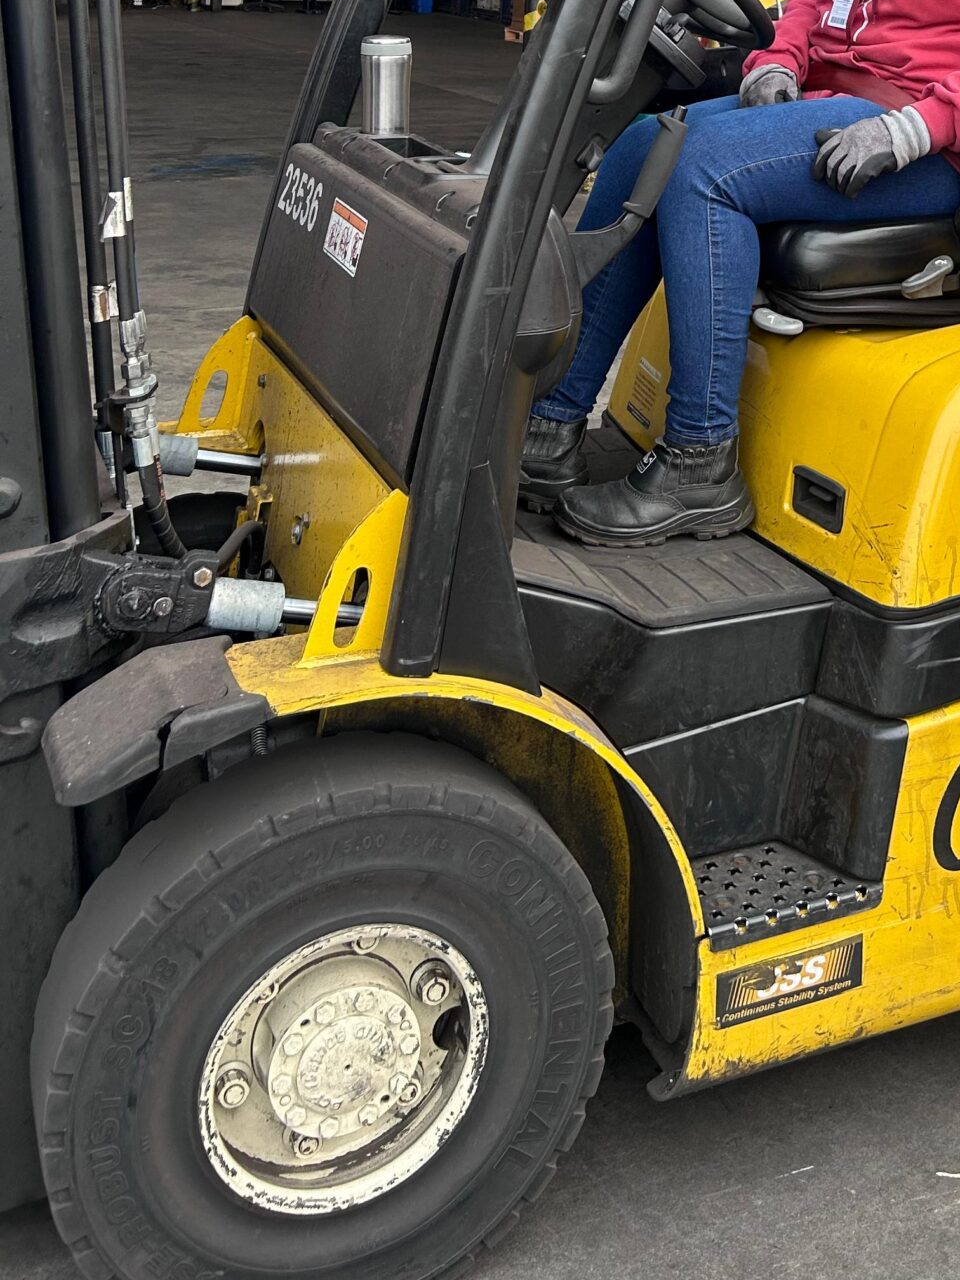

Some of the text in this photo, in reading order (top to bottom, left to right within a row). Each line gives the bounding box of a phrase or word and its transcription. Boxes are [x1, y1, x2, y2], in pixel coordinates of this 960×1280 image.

[278, 163, 323, 232] 23536
[722, 979, 852, 1023] Continuous Stability System
